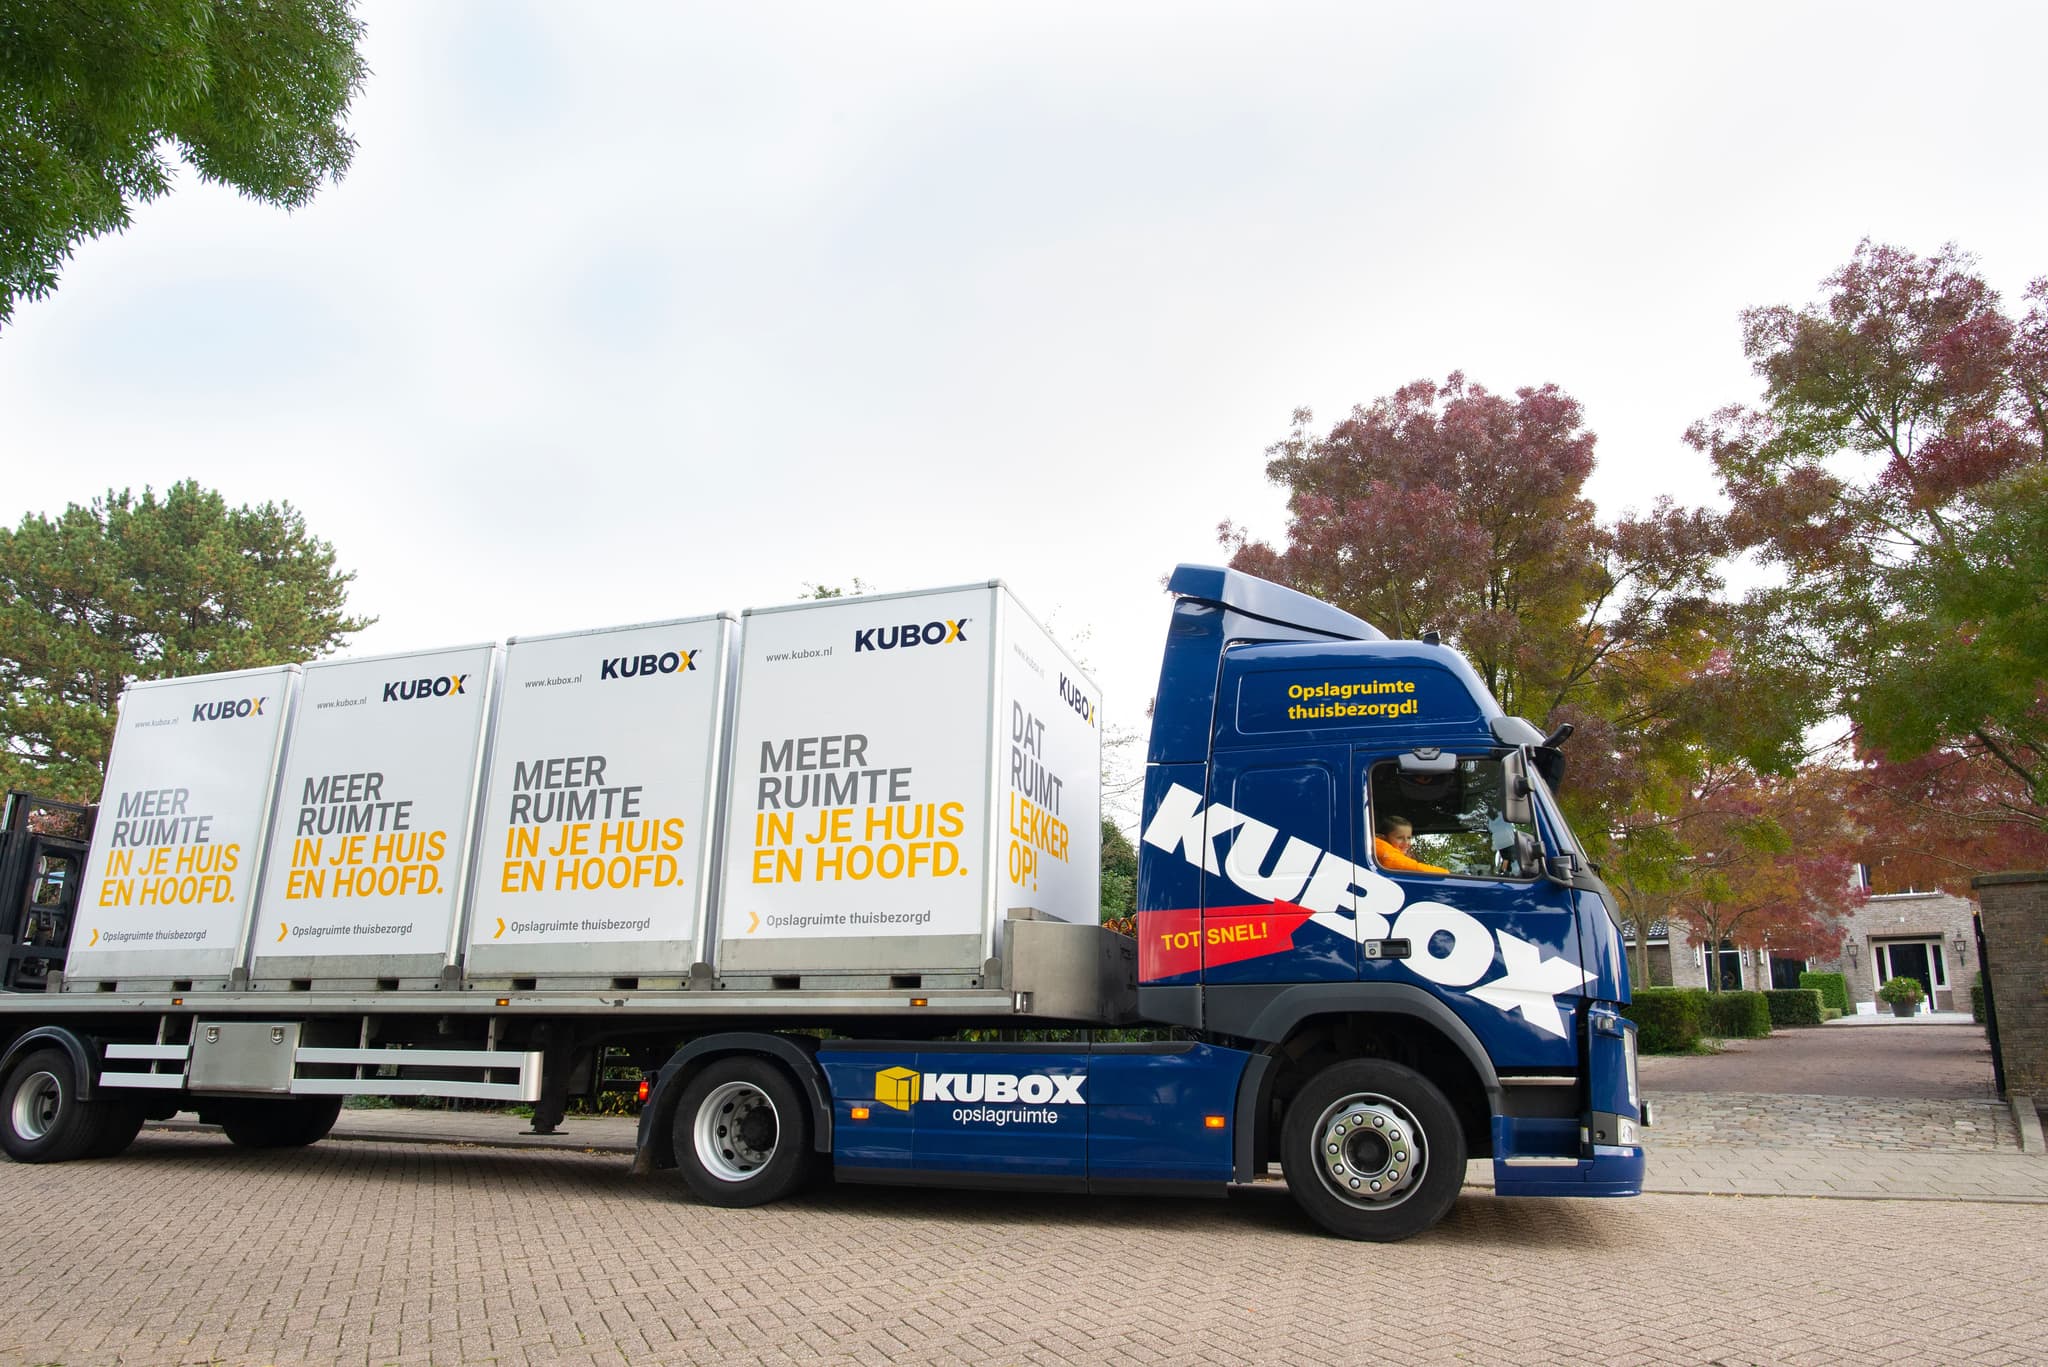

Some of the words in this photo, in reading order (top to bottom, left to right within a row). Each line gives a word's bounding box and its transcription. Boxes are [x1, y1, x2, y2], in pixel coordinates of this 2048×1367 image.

[855, 619, 968, 652] KUBOX
[601, 649, 698, 680] KUBOX
[766, 647, 833, 662] www.kubox.nl
[383, 674, 467, 702] KUBOX
[525, 675, 582, 688] www.kubox.nl
[1288, 680, 1415, 701] Opslagruimte
[192, 697, 266, 721] KUBOX
[317, 697, 367, 710] www.kubox.nl
[1059, 672, 1095, 728] KUBOX
[1288, 700, 1418, 720] thuisbezorgd!
[1012, 700, 1045, 759] DAT
[760, 734, 868, 773] MEER
[302, 772, 383, 805] MEER
[513, 755, 607, 791] MEER
[757, 768, 912, 809] RUIMTE
[1011, 745, 1063, 815] RUIMT
[117, 788, 189, 818] MEER
[297, 801, 413, 836] RUIMTE
[510, 786, 642, 824] RUIMTE
[111, 816, 213, 847] RUIMTE
[506, 826, 541, 858] IN
[549, 823, 590, 855] JE
[599, 818, 685, 853] HUIS
[755, 813, 794, 846] IN
[806, 809, 852, 843] JE
[865, 802, 964, 841] HUIS
[1009, 792, 1069, 863] LEKKER
[105, 849, 132, 876] IN
[138, 847, 171, 875] JE
[176, 844, 240, 873] HUIS
[292, 837, 322, 867] IN
[329, 834, 366, 865] JE
[373, 830, 447, 863] HUIS
[752, 849, 804, 883] EN
[816, 842, 968, 881] HOOFD.
[286, 870, 325, 900] EN
[332, 865, 444, 898] HOOFD.
[501, 860, 546, 892] EN
[555, 854, 684, 891] HOOFD.
[1009, 846, 1038, 892] OP!
[99, 879, 134, 907] EN
[139, 875, 235, 905] HOOFD.
[511, 920, 579, 933] Opslagruimte
[581, 918, 650, 931] thuisbezorgd
[766, 913, 847, 927] Opslagruimte
[849, 910, 931, 924] thuisbezorgd
[1144, 783, 1598, 1039] KUBOX
[102, 931, 154, 943] Opslagruimte
[155, 928, 206, 941] thuisbezorgd
[292, 925, 351, 938] Opslagruimte
[353, 923, 412, 936] thuisbezorgd
[1161, 932, 1201, 951] TOT
[1207, 923, 1267, 945] SNEL!
[923, 1073, 1087, 1105] KUBOX
[952, 1106, 1058, 1126] opslagruimte
